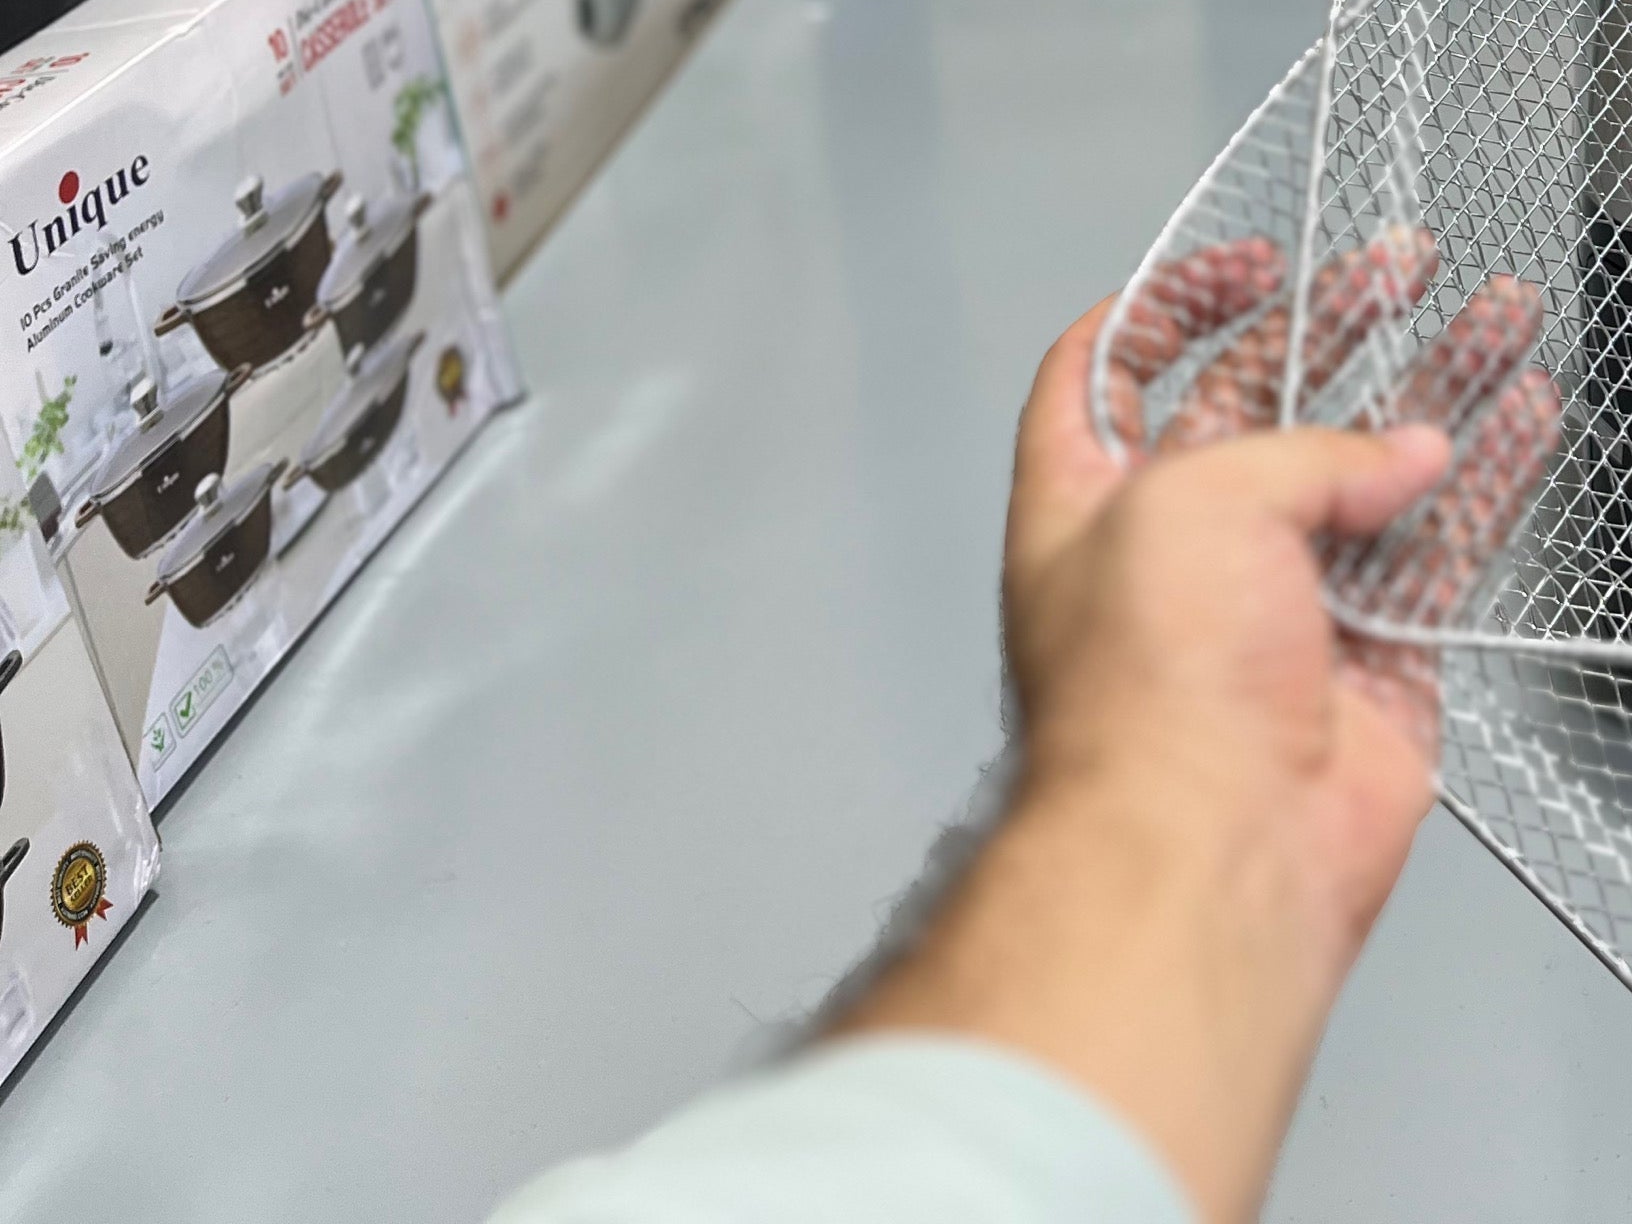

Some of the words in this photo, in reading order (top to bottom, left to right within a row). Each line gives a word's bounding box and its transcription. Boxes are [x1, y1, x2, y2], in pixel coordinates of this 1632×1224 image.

[8, 155, 150, 275] Unique
[20, 312, 33, 331] 10
[33, 297, 52, 320] Pcs
[53, 264, 89, 302] Granite
[90, 236, 127, 270] Saving
[128, 208, 165, 241] energy
[26, 304, 74, 353] Aluminum
[74, 261, 125, 308] Cookware
[125, 245, 144, 268] Set
[64, 863, 89, 896] BEST
